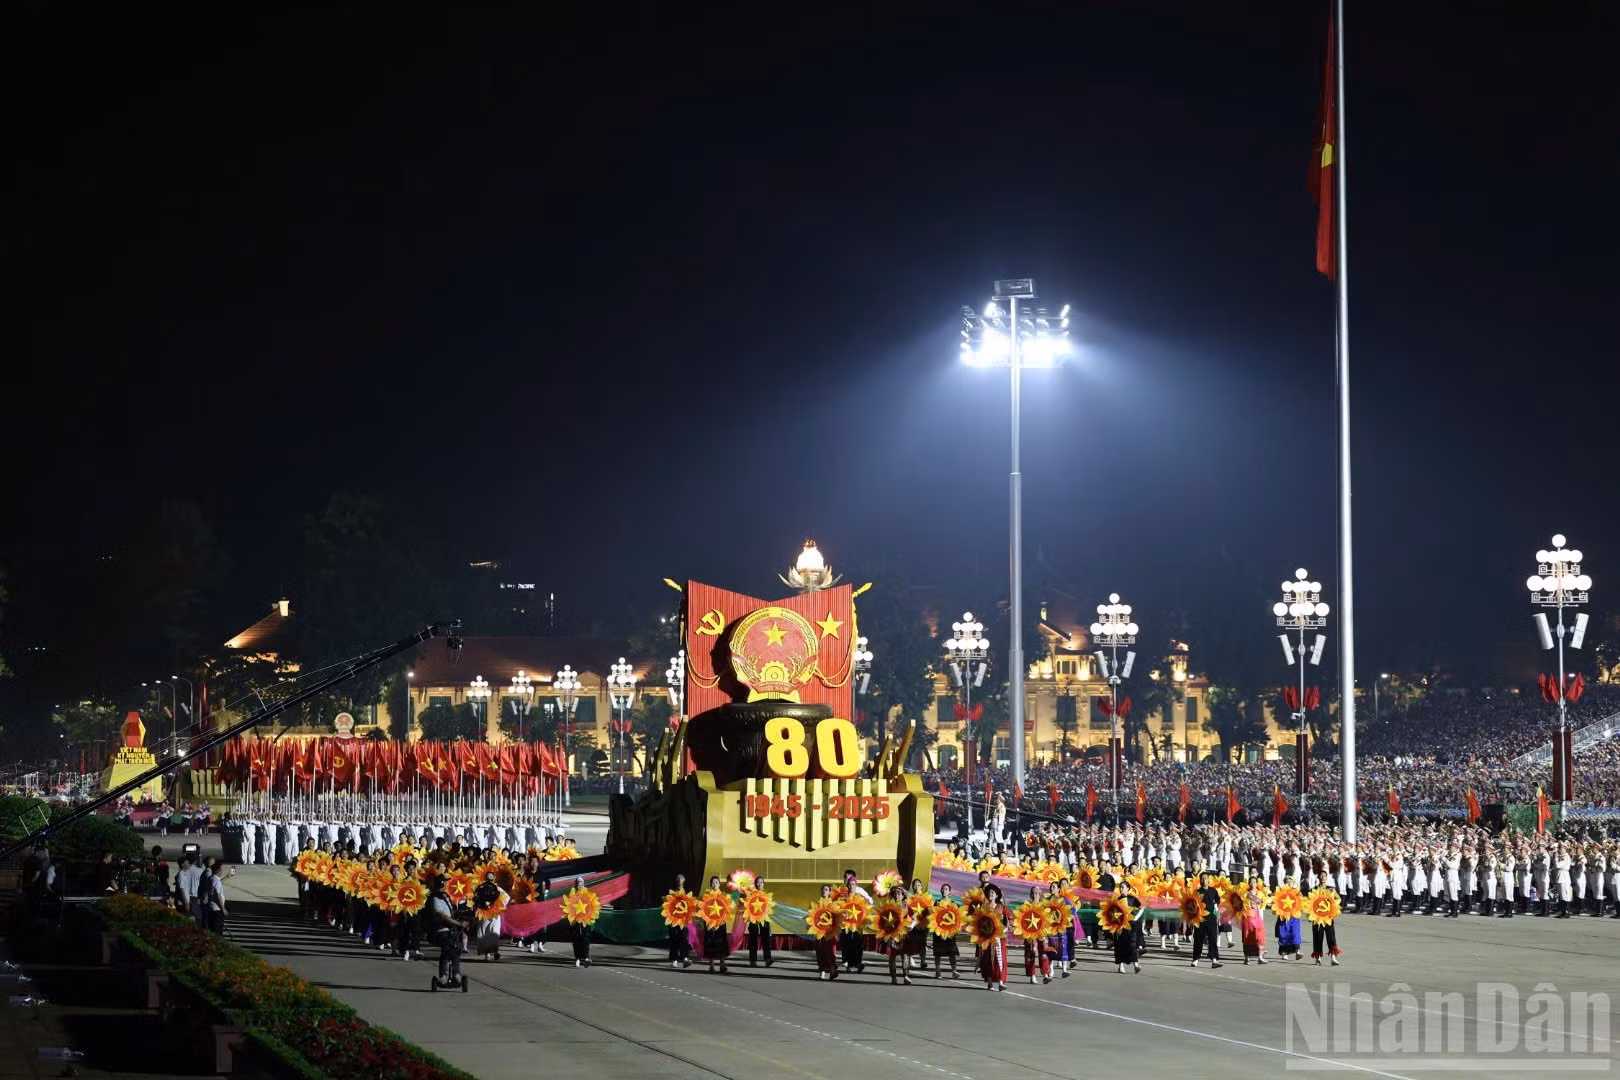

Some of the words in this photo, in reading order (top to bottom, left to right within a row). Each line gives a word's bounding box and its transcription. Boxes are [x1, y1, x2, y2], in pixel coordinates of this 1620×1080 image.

[765, 717, 860, 777] 80
[745, 794, 802, 819] 1945
[828, 795, 890, 820] 2025
